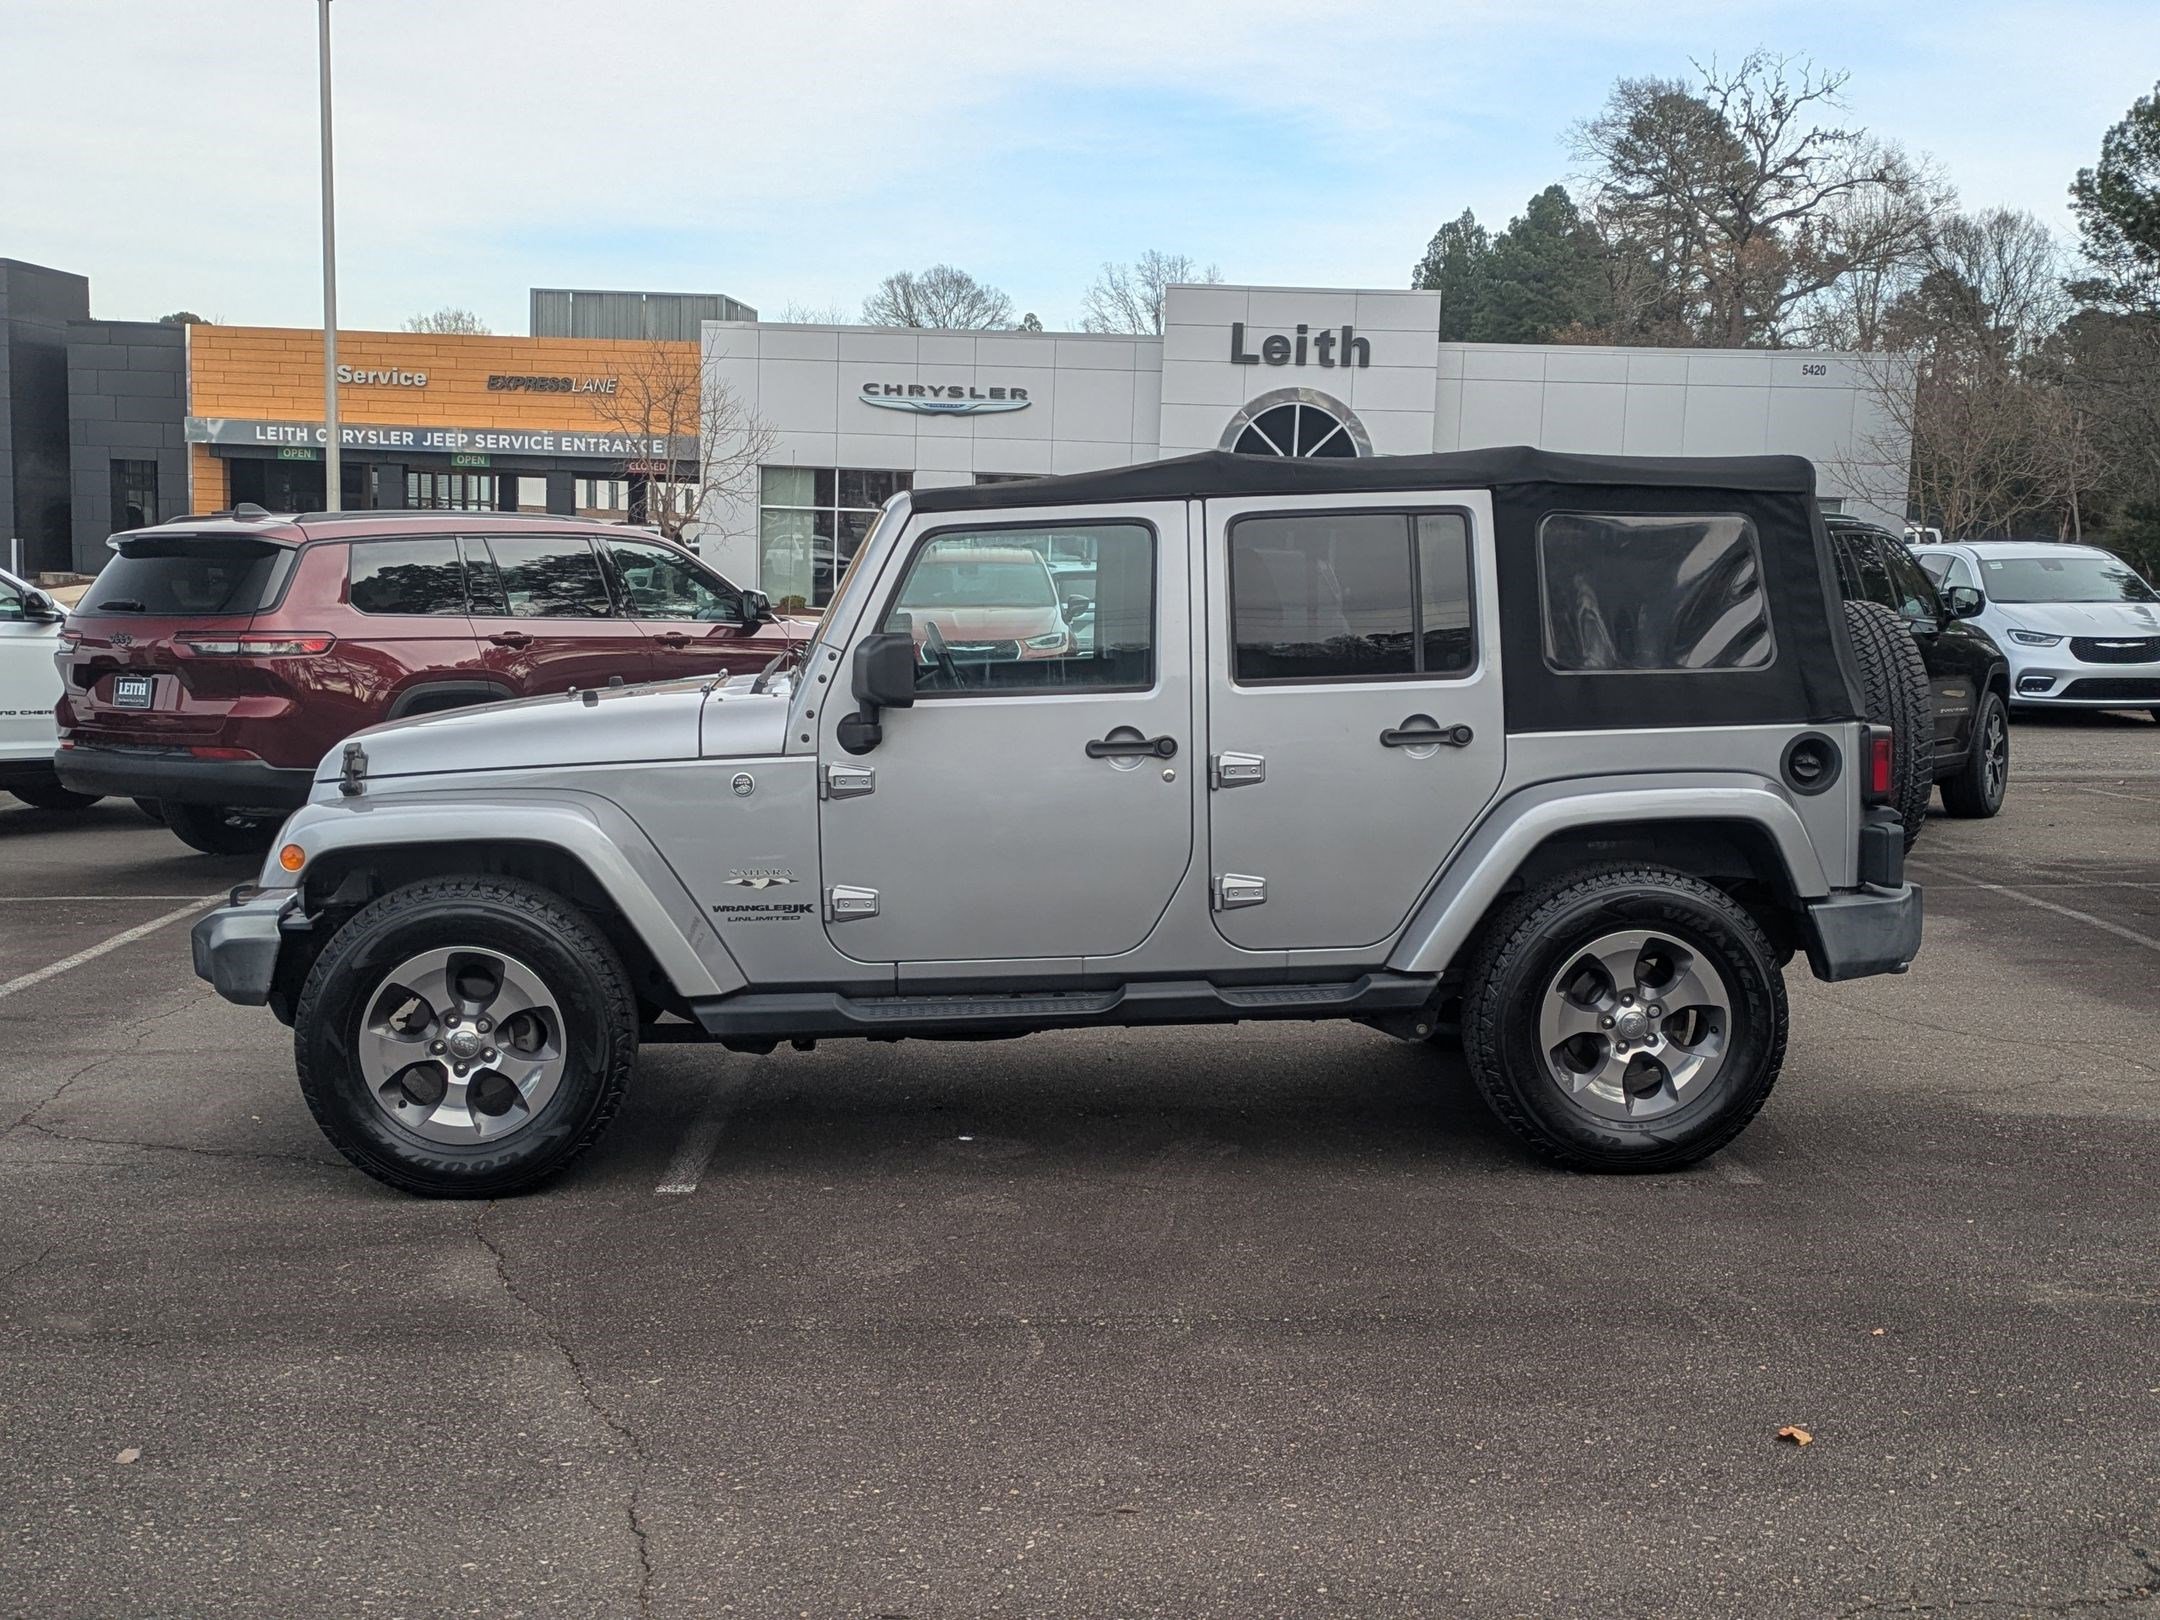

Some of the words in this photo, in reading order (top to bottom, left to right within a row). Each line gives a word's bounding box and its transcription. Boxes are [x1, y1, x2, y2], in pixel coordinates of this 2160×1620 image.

[1231, 322, 1370, 368] Leith
[336, 364, 428, 387] Service
[1802, 364, 1827, 376] 5420
[862, 383, 1028, 400] CHRYSLER
[255, 425, 309, 442] LEITH
[315, 427, 414, 446] CRYSLER
[422, 431, 469, 448] JEEP
[474, 433, 555, 451] SERVICE
[561, 436, 664, 454] ENTRANCE
[282, 448, 312, 459] OPEN
[456, 455, 486, 466] OPEN
[118, 682, 148, 697] LEITH
[729, 868, 795, 877] SAHARA
[727, 915, 801, 923] UNLIMITED
